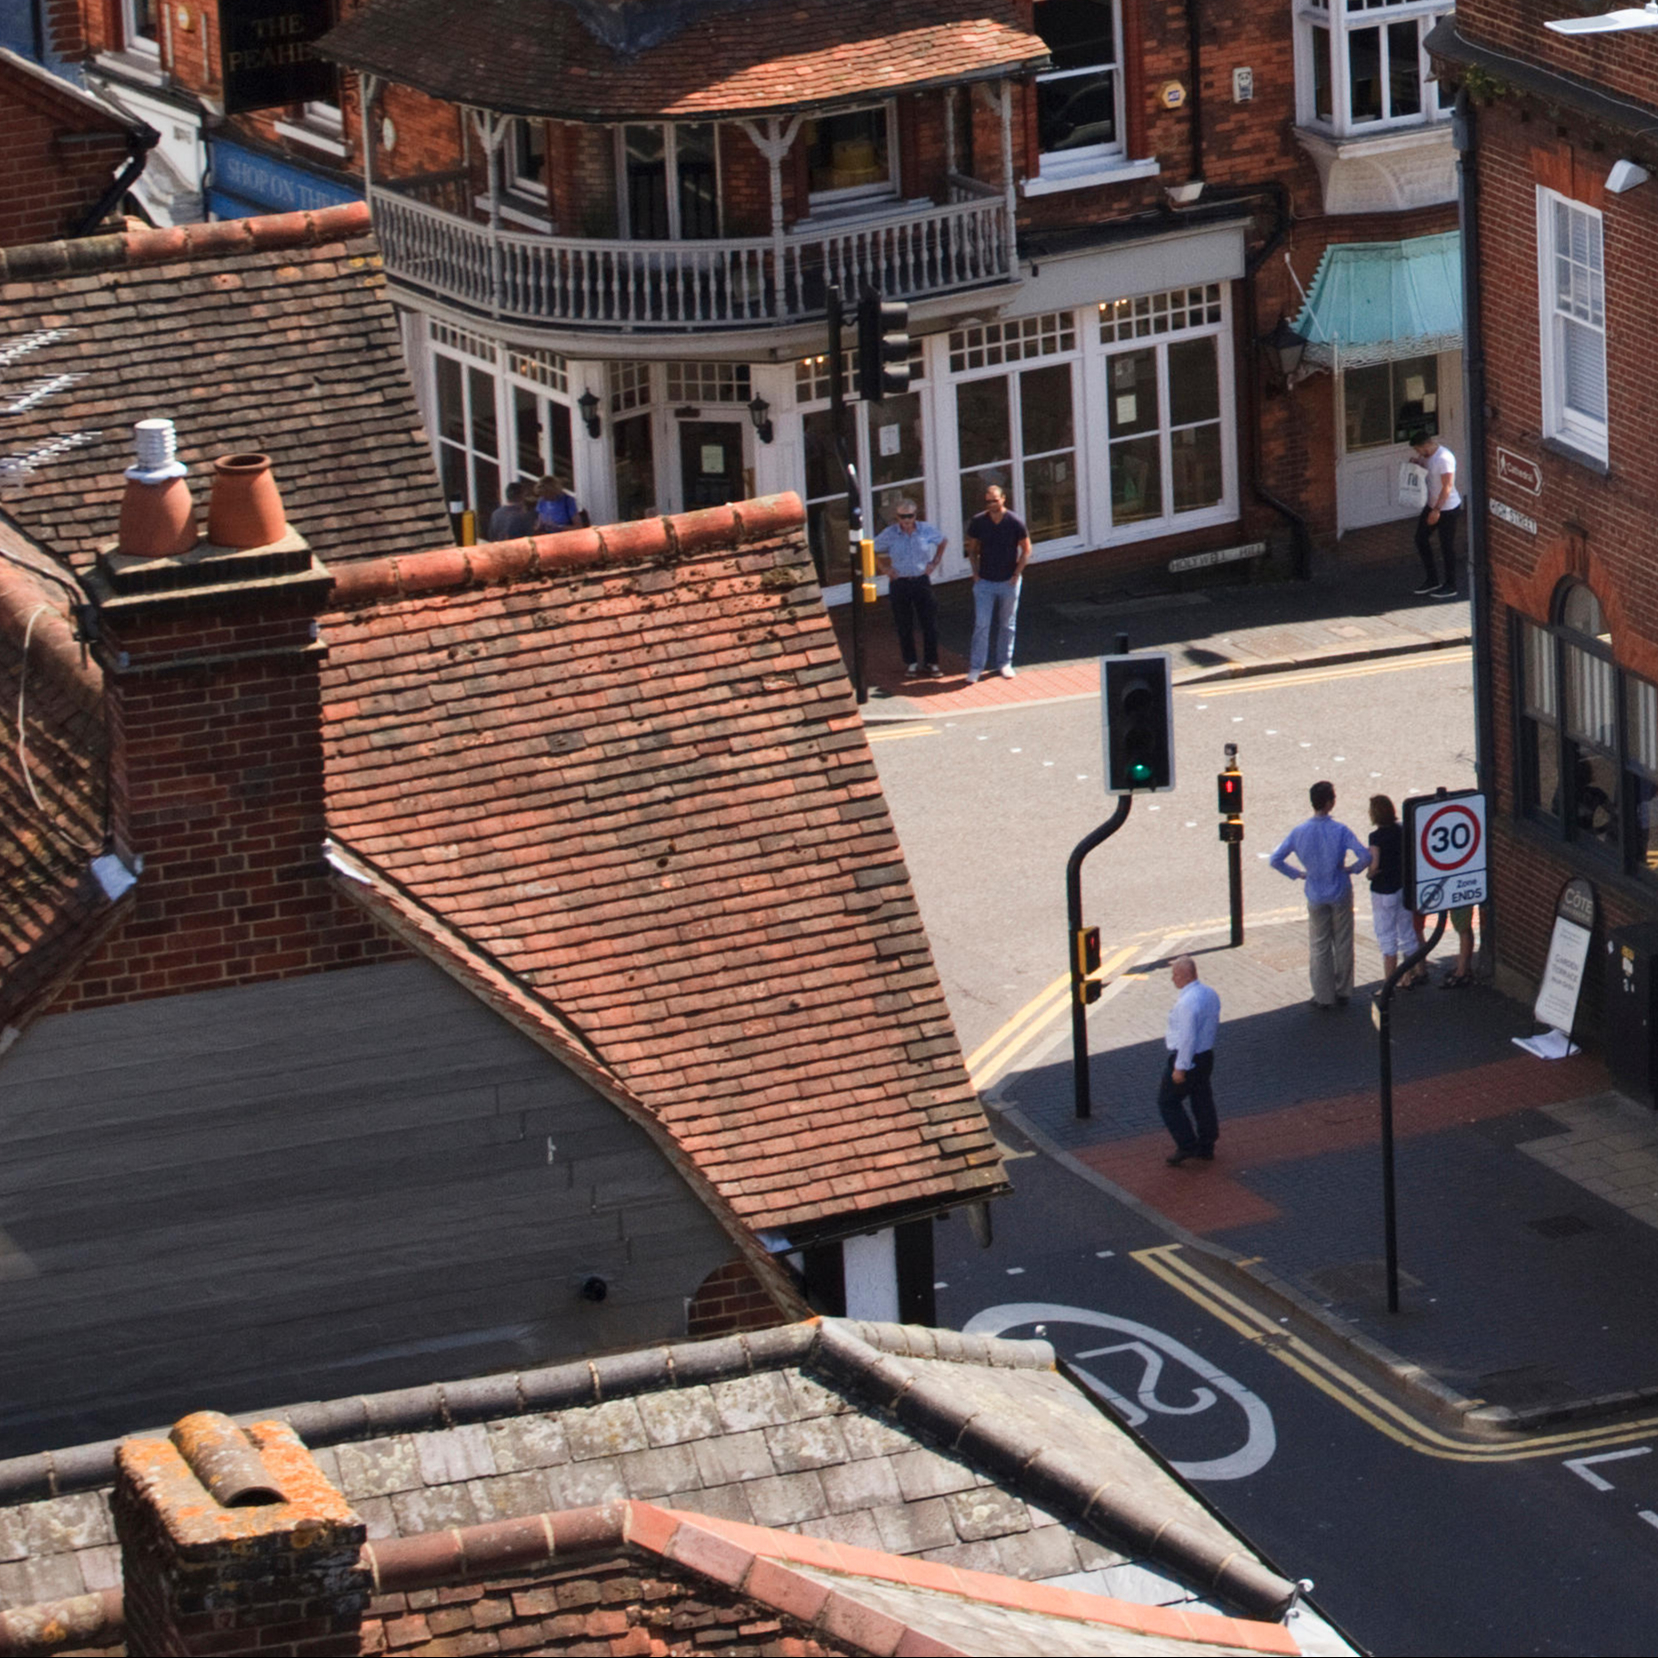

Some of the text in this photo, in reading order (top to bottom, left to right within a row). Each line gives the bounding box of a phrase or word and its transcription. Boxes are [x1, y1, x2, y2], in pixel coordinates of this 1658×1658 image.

[251, 12, 305, 37] THE
[228, 41, 312, 72] PEAHE
[228, 157, 270, 193] SHOP
[271, 173, 295, 203] ON
[1431, 823, 1471, 853] 30
[1451, 888, 1482, 903] ENDS
[1456, 879, 1478, 889] Zone
[1564, 887, 1594, 914] CÔTE
